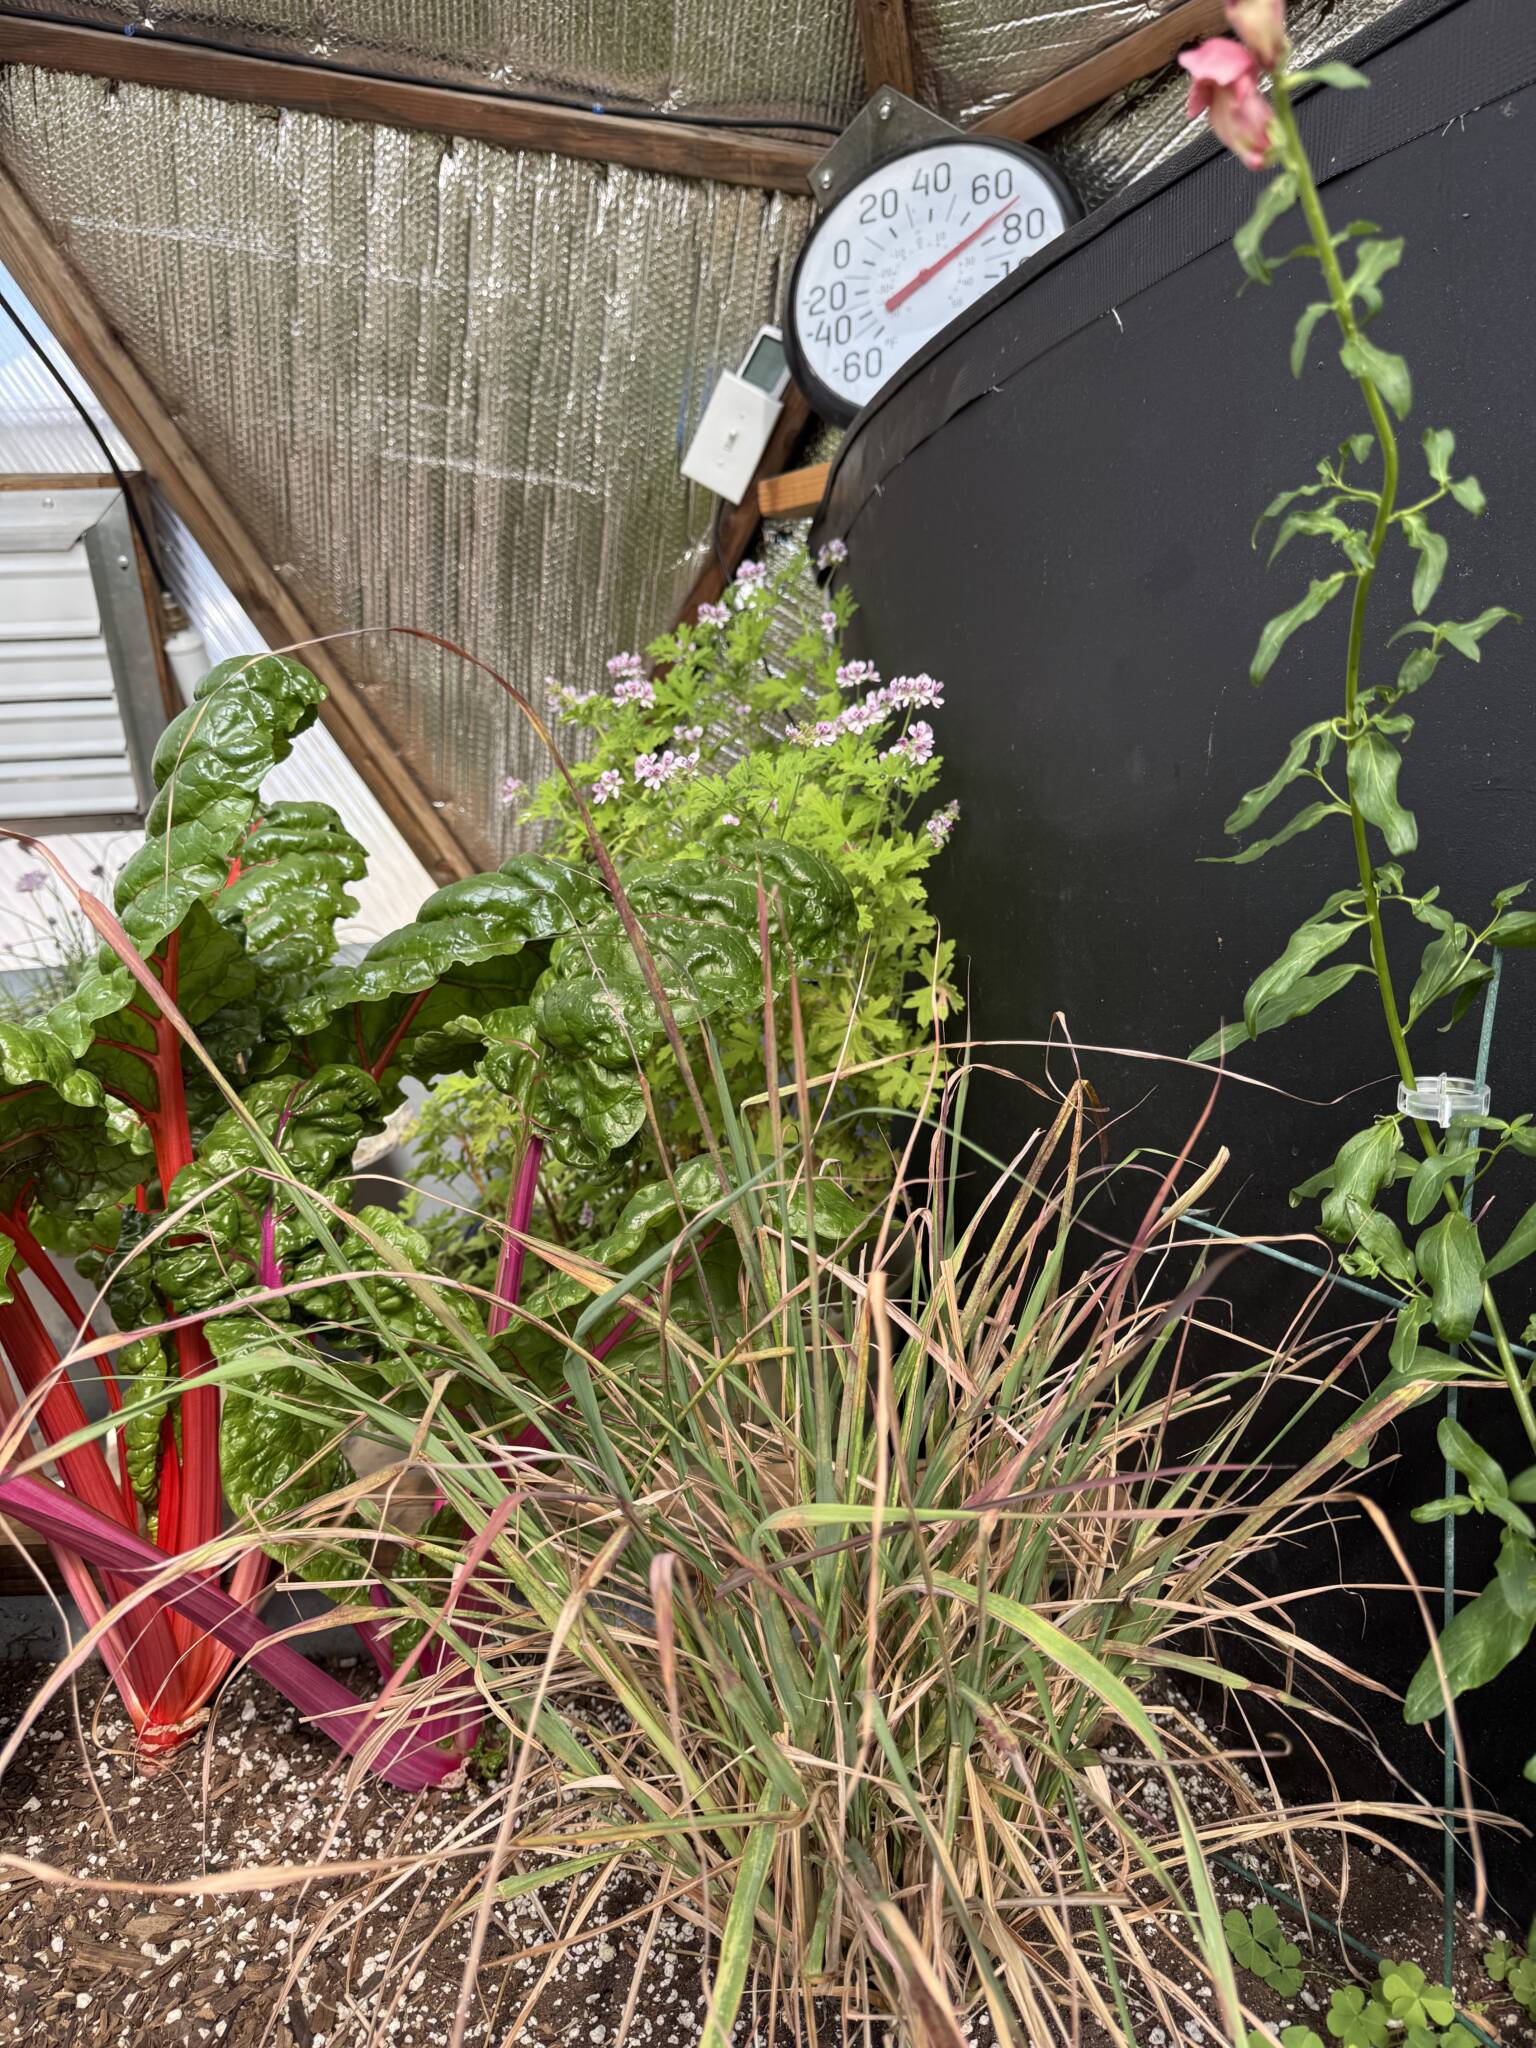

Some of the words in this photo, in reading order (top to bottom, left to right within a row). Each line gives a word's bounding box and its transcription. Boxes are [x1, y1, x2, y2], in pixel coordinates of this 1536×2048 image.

[912, 162, 951, 196] 40
[971, 168, 1012, 205] 60
[859, 188, 898, 225] 20
[1003, 208, 1045, 244] 80
[834, 239, 850, 269] 0
[802, 281, 846, 316] -20
[807, 314, 851, 347] -40
[833, 347, 882, 383] -60
